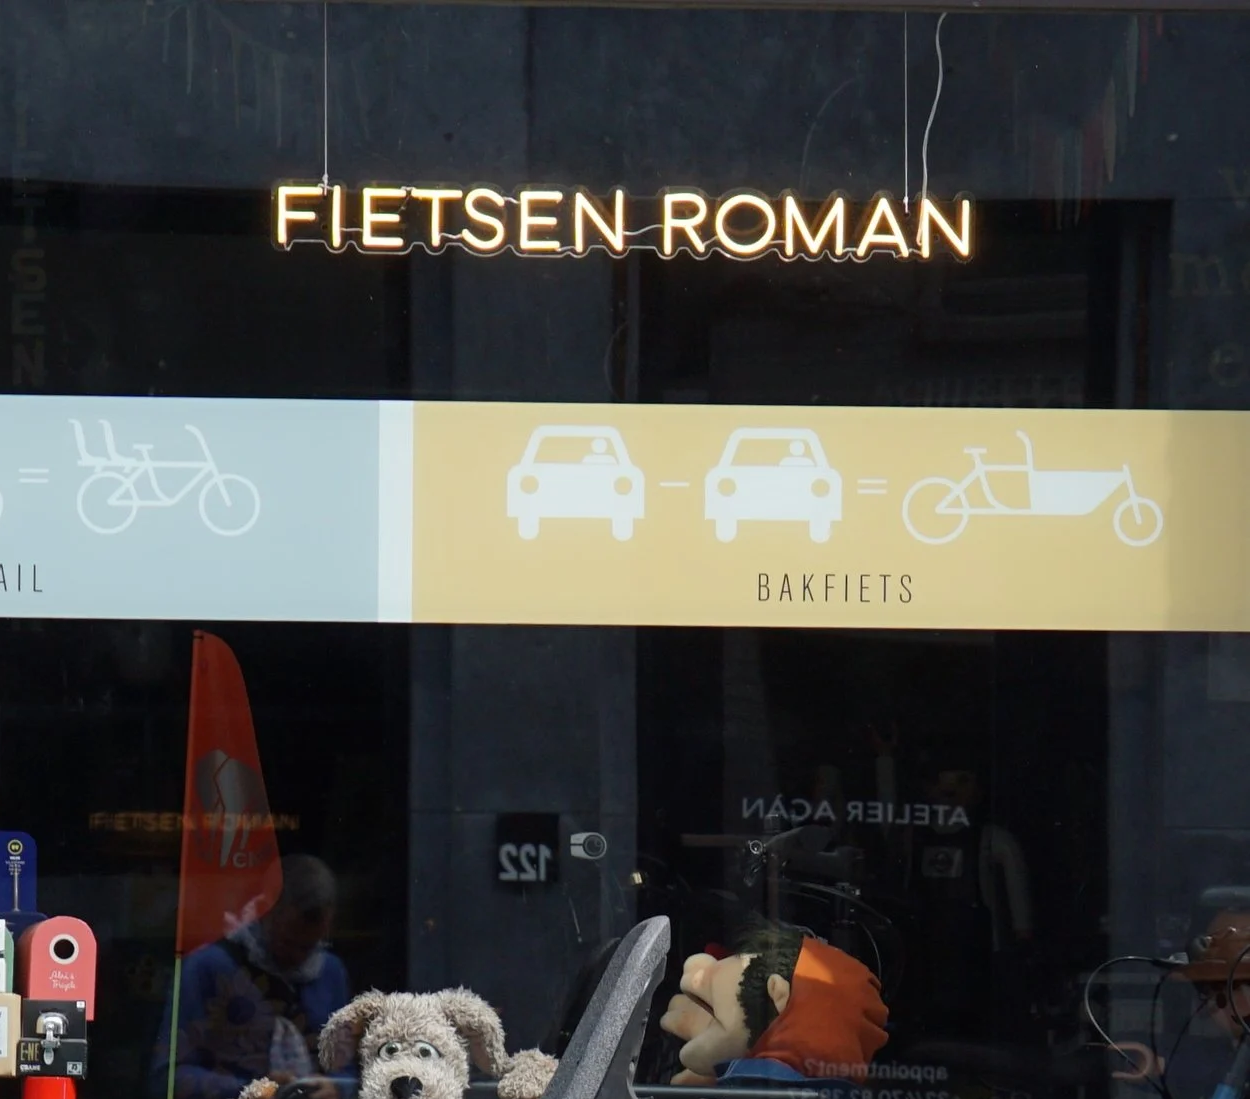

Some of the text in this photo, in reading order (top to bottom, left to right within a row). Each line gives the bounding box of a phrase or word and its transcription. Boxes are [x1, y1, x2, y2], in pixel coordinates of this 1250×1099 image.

[275, 185, 973, 259] FIETSEN ROMAN
[756, 572, 915, 604] BAKFIETS
